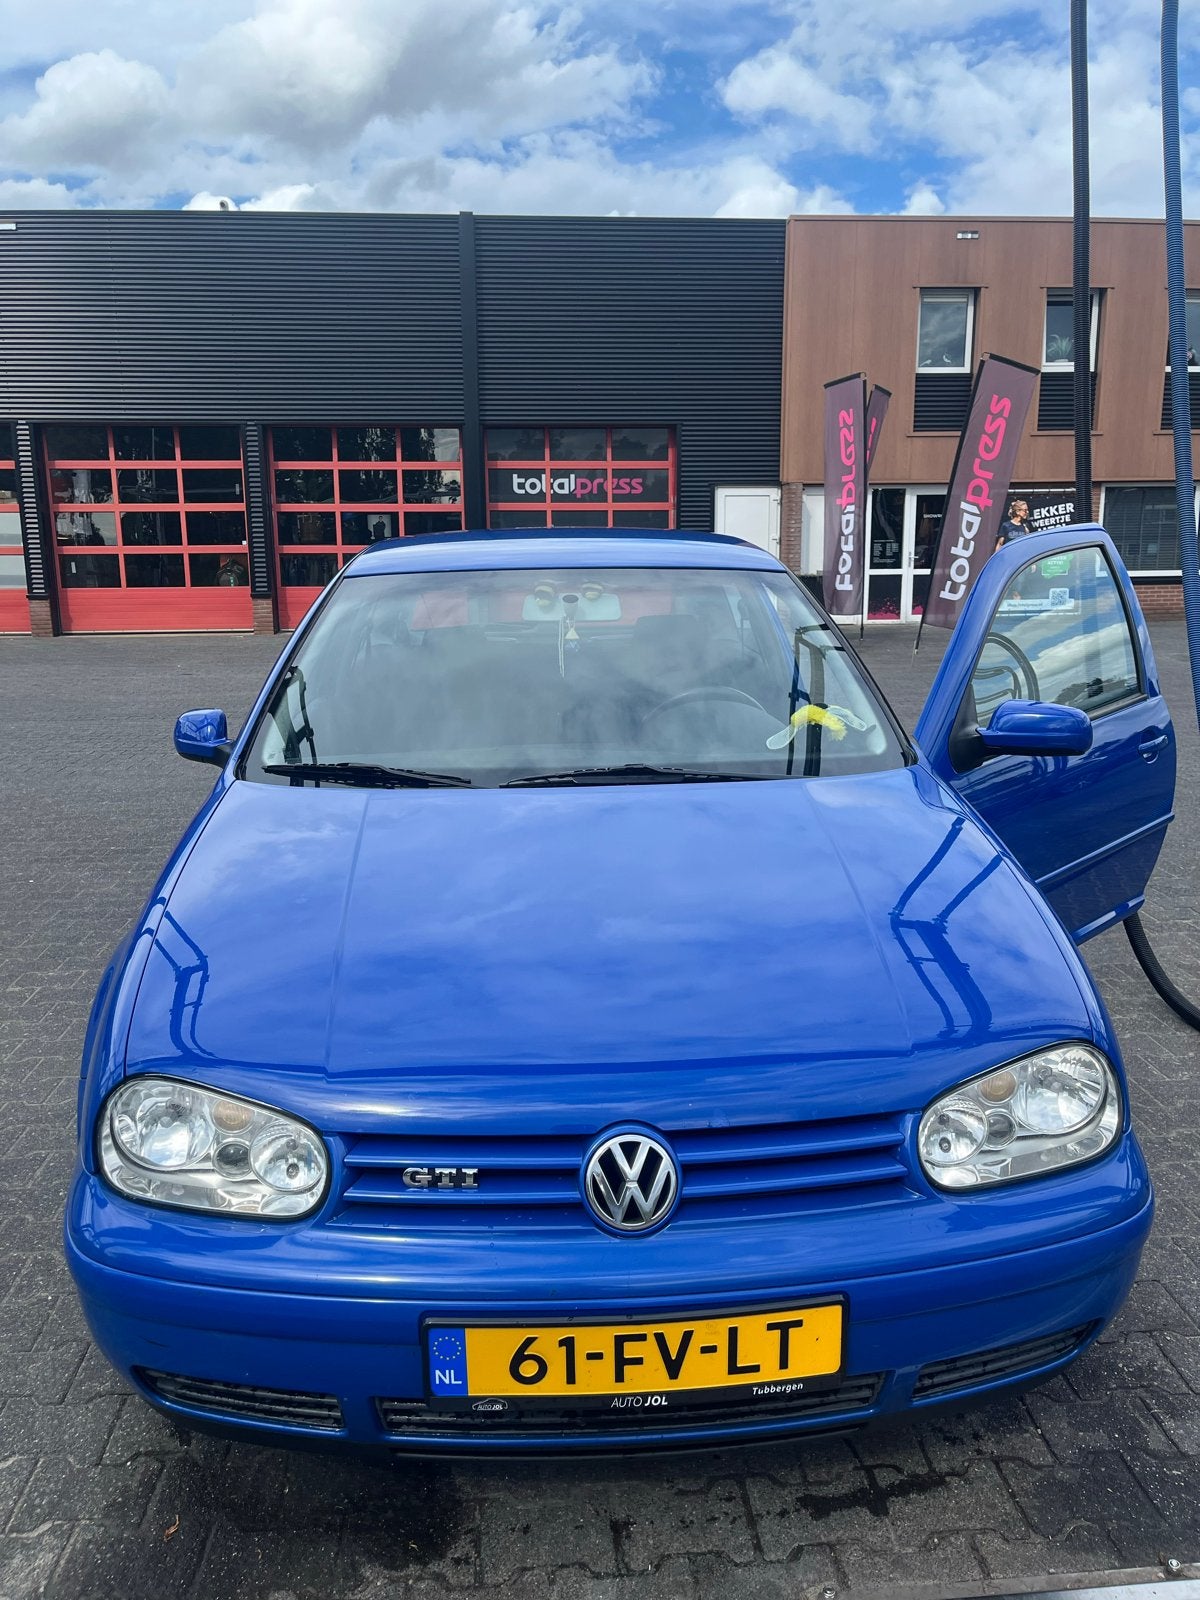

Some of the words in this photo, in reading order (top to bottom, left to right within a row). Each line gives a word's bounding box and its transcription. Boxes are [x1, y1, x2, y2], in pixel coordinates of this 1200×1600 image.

[512, 473, 644, 498] totalpress
[939, 394, 1012, 601] totalpress
[1029, 502, 1075, 520] EKKER
[402, 1167, 478, 1189] GTI
[508, 1318, 804, 1386] 61-FV-LT
[435, 1369, 463, 1385] NL
[752, 1382, 804, 1396] Tubbergen
[610, 1396, 643, 1409] AUTO
[644, 1395, 669, 1407] JOL
